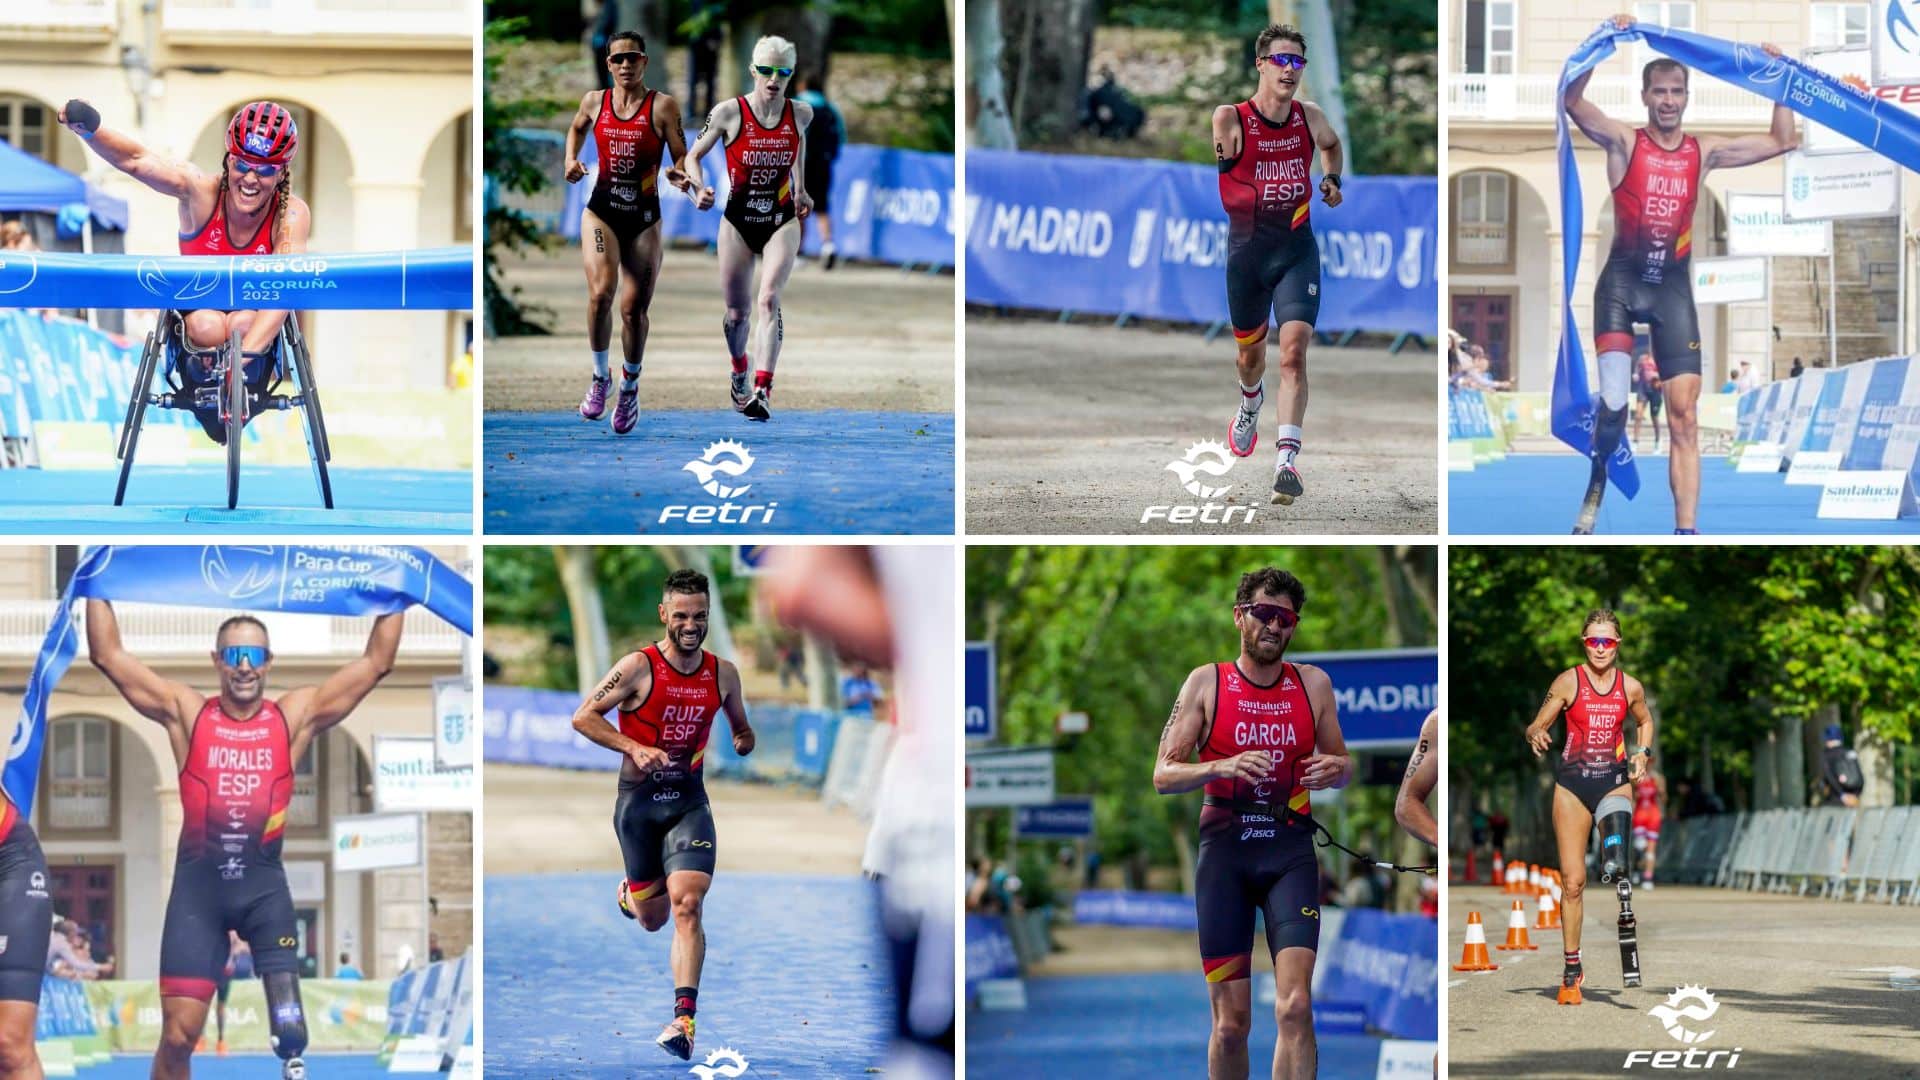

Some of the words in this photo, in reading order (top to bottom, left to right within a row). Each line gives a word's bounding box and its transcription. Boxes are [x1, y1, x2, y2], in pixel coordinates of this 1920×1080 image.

[1790, 88, 1814, 107] 2023
[609, 140, 636, 157] GUIDE
[742, 150, 793, 166] RODRIGUEZ
[610, 157, 635, 175] ESP
[1255, 157, 1305, 180] RIUDAVETS
[750, 168, 778, 185] ESP
[1647, 174, 1688, 198] MOLINA
[1262, 182, 1305, 201] ESP
[1645, 197, 1680, 218] ESP
[988, 202, 1114, 259] MADRID
[241, 258, 286, 273] Para
[289, 258, 328, 277] Cup
[242, 281, 255, 289] A
[259, 278, 338, 289] CORUÑA
[242, 290, 280, 301] 2023
[294, 551, 334, 572] Para
[337, 556, 373, 574] Cup
[289, 588, 325, 602] 2023
[594, 671, 623, 702] 528
[1332, 683, 1438, 713] MADRI
[662, 705, 706, 723] RUIZ
[1589, 714, 1617, 729] MATEO
[662, 724, 697, 741] ESP
[1235, 721, 1297, 747] GARCIA
[1588, 730, 1613, 745] ESP
[207, 745, 273, 771] MORALES
[217, 773, 261, 796] ESP
